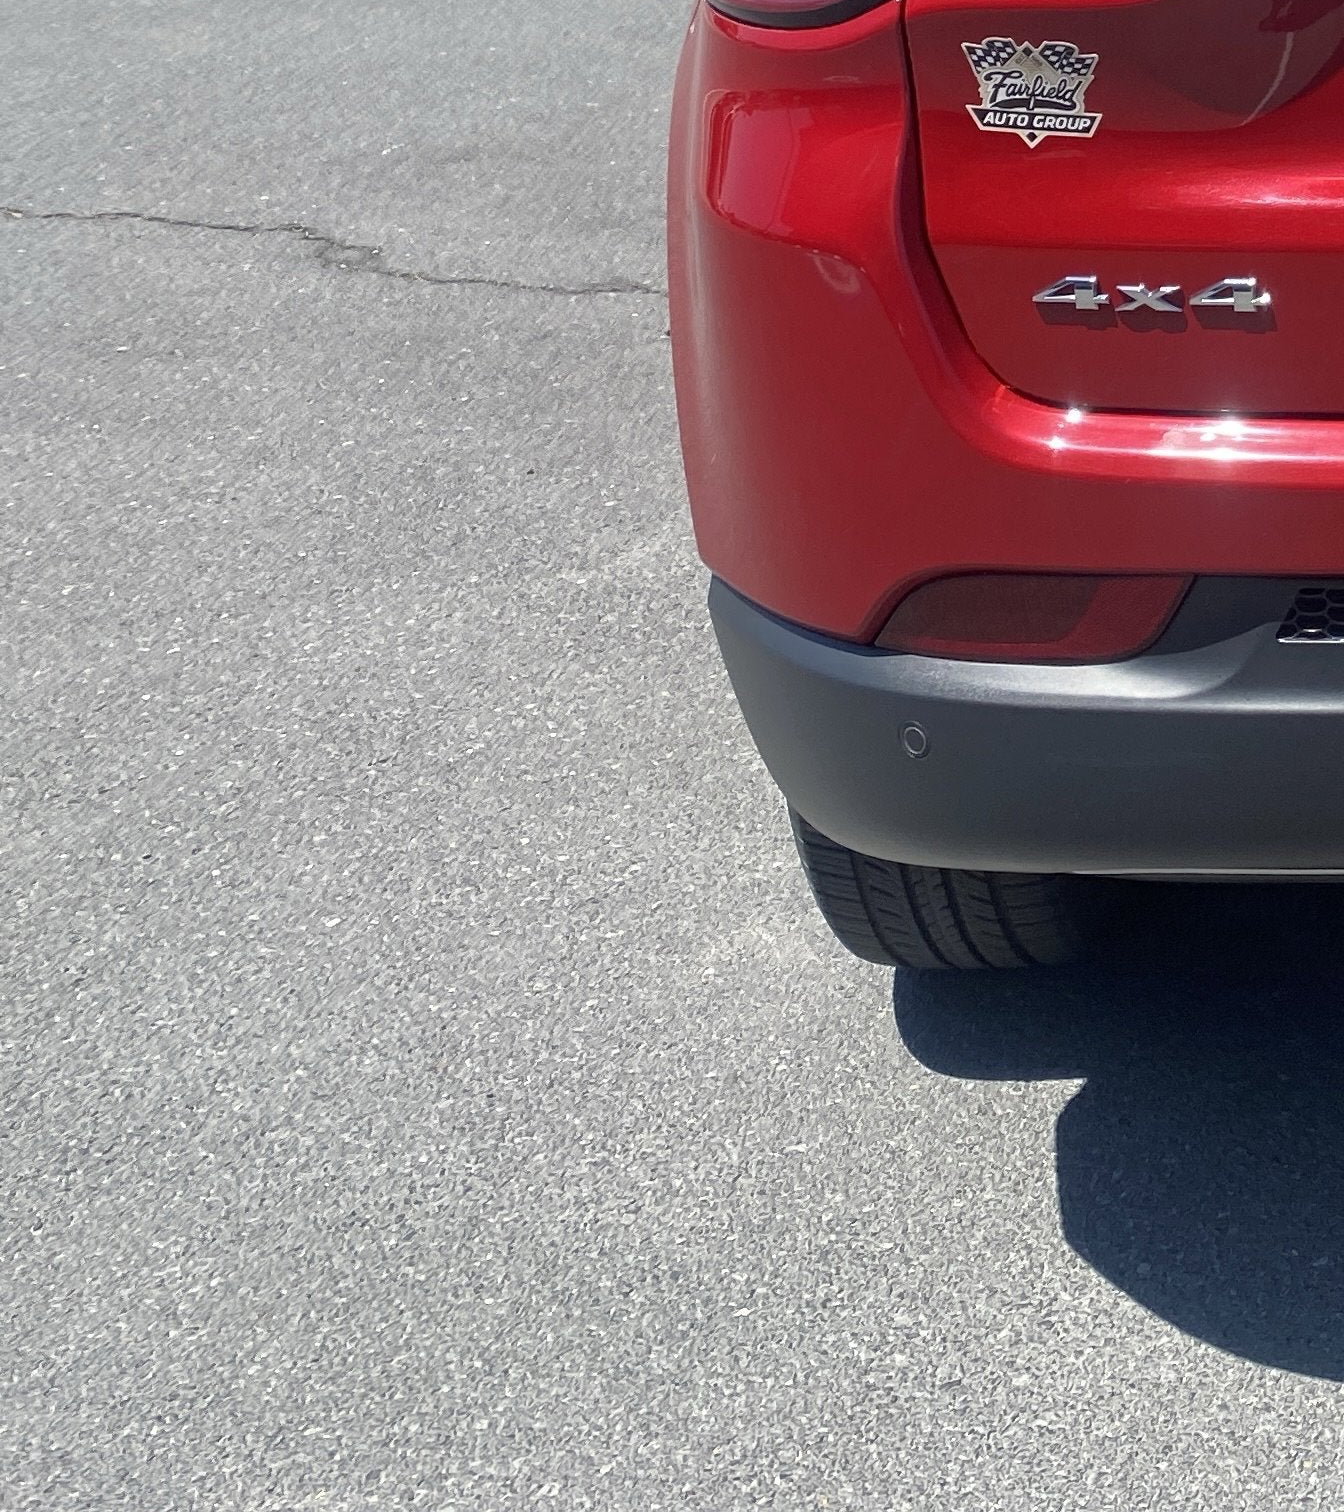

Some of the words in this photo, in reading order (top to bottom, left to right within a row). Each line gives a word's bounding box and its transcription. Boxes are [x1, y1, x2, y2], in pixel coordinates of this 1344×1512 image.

[984, 70, 1083, 110] Fairfield
[983, 111, 1027, 128] AUTO
[1032, 115, 1091, 131] GROUP
